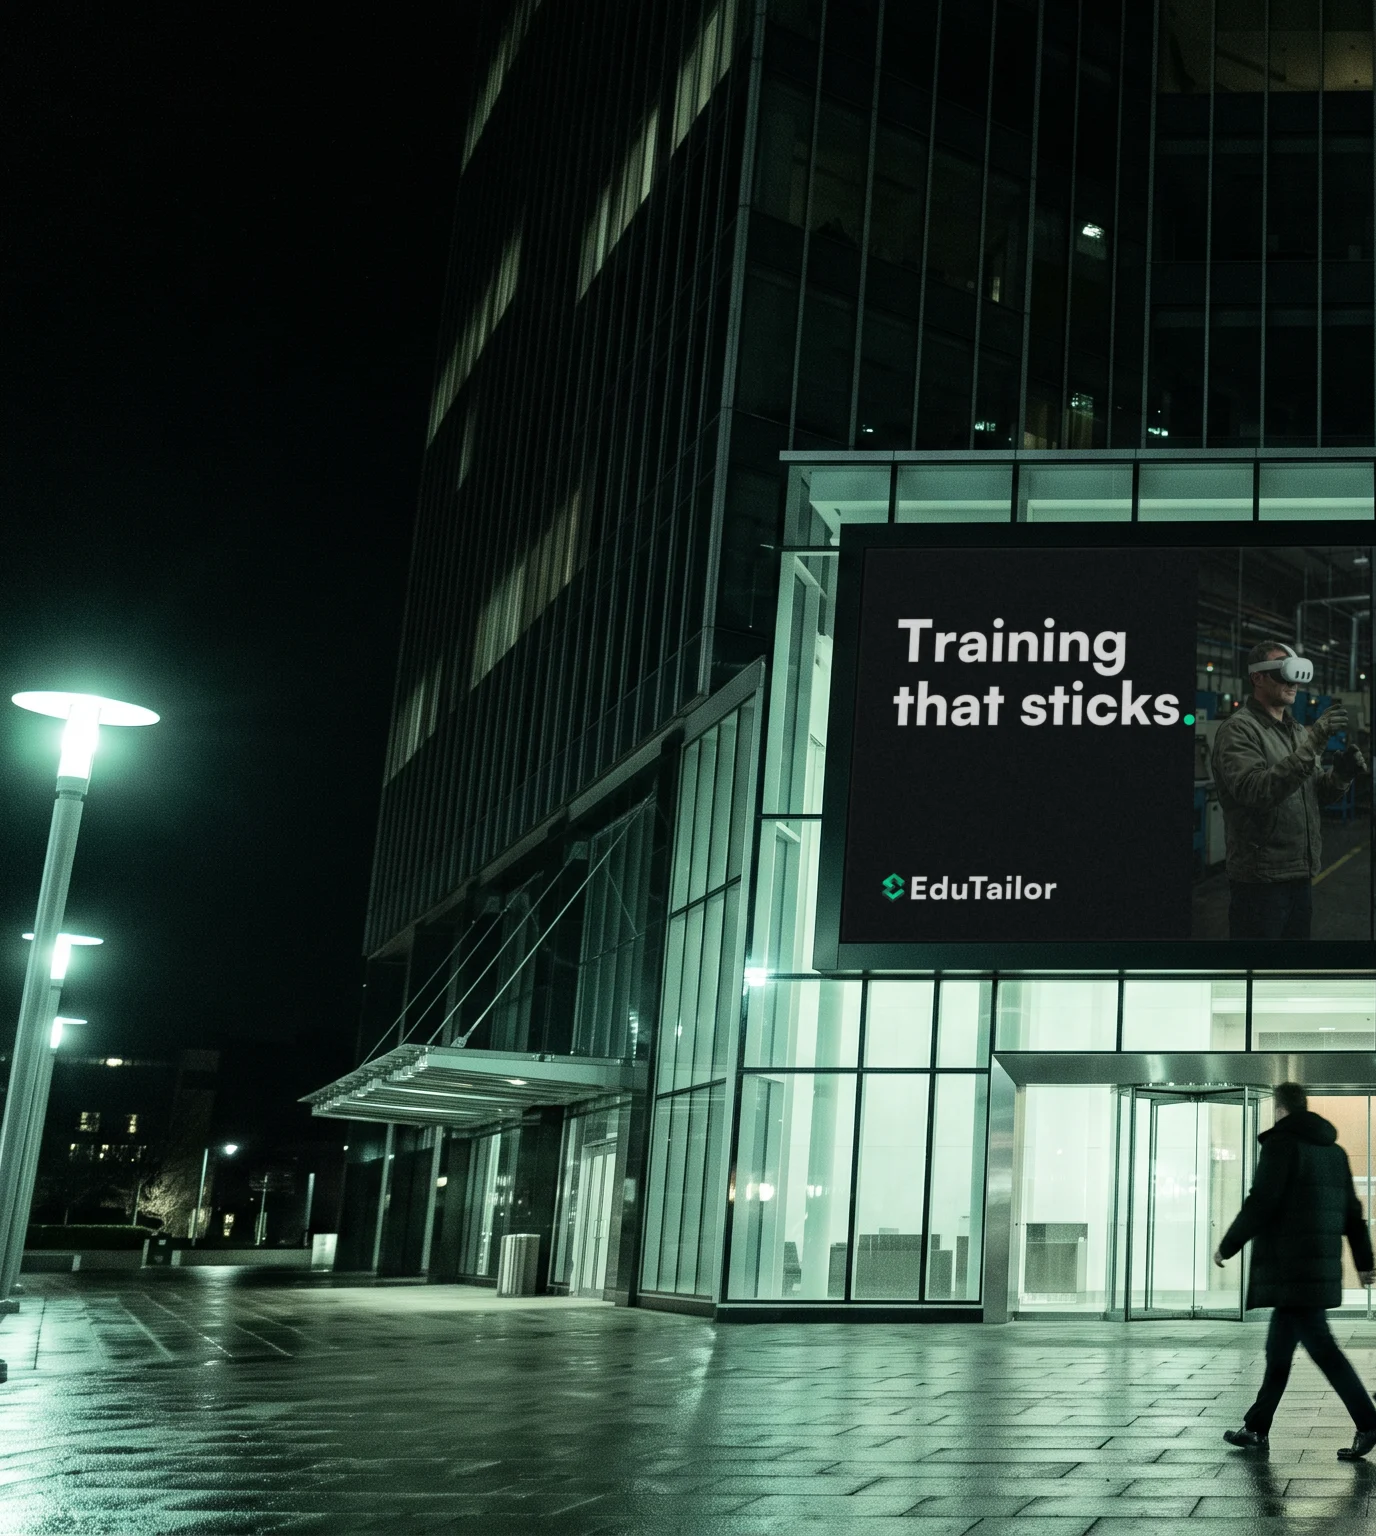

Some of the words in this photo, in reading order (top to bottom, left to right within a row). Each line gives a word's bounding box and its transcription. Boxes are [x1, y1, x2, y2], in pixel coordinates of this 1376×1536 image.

[898, 618, 1126, 676] Training
[893, 681, 1004, 726] that
[1020, 680, 1195, 726] sticks.
[911, 875, 1057, 900] EduTailor
